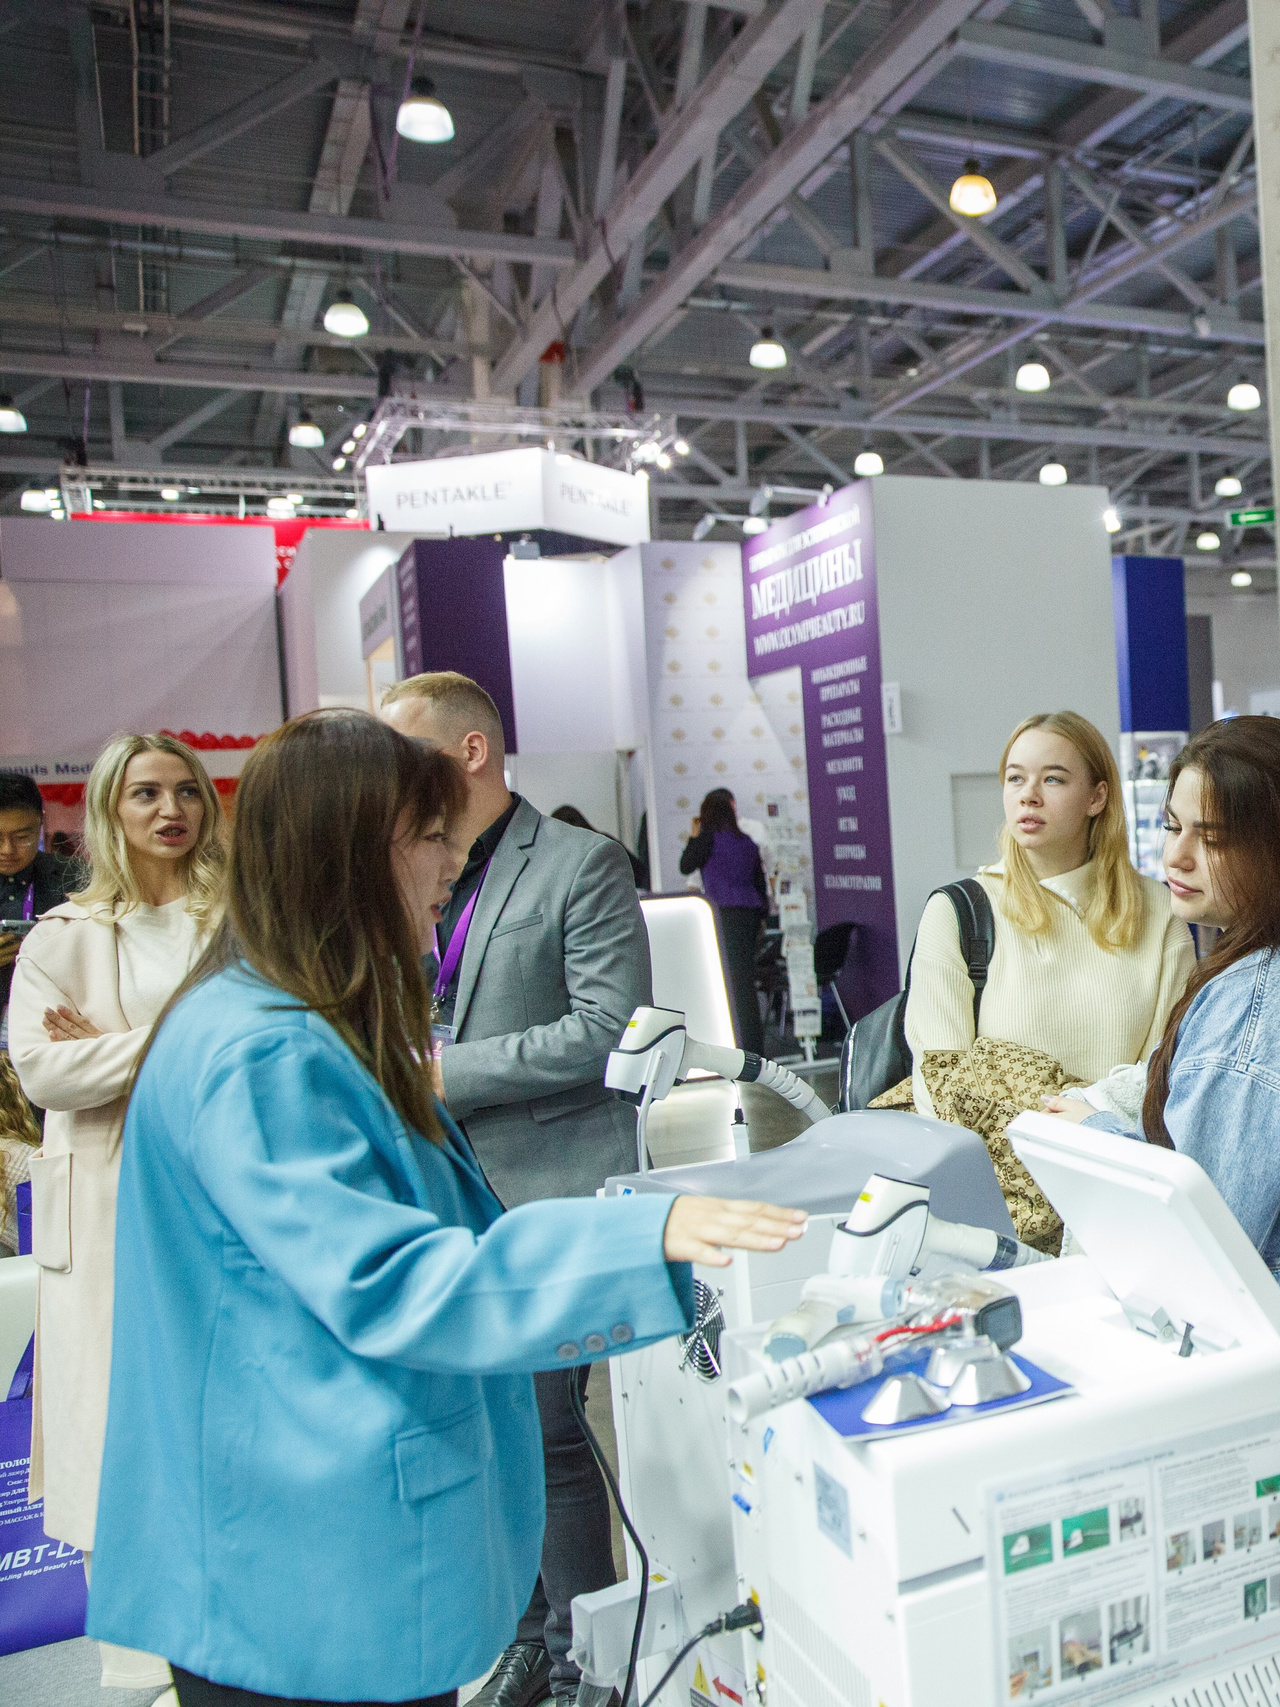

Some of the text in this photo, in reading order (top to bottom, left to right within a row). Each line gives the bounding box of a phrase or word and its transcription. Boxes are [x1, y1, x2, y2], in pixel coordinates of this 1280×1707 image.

[396, 482, 508, 510] PENTAKLE
[751, 538, 863, 620] МЕДИЦИНЫ
[23, 1567, 42, 1577] Mega
[43, 1562, 67, 1572] Beauty
